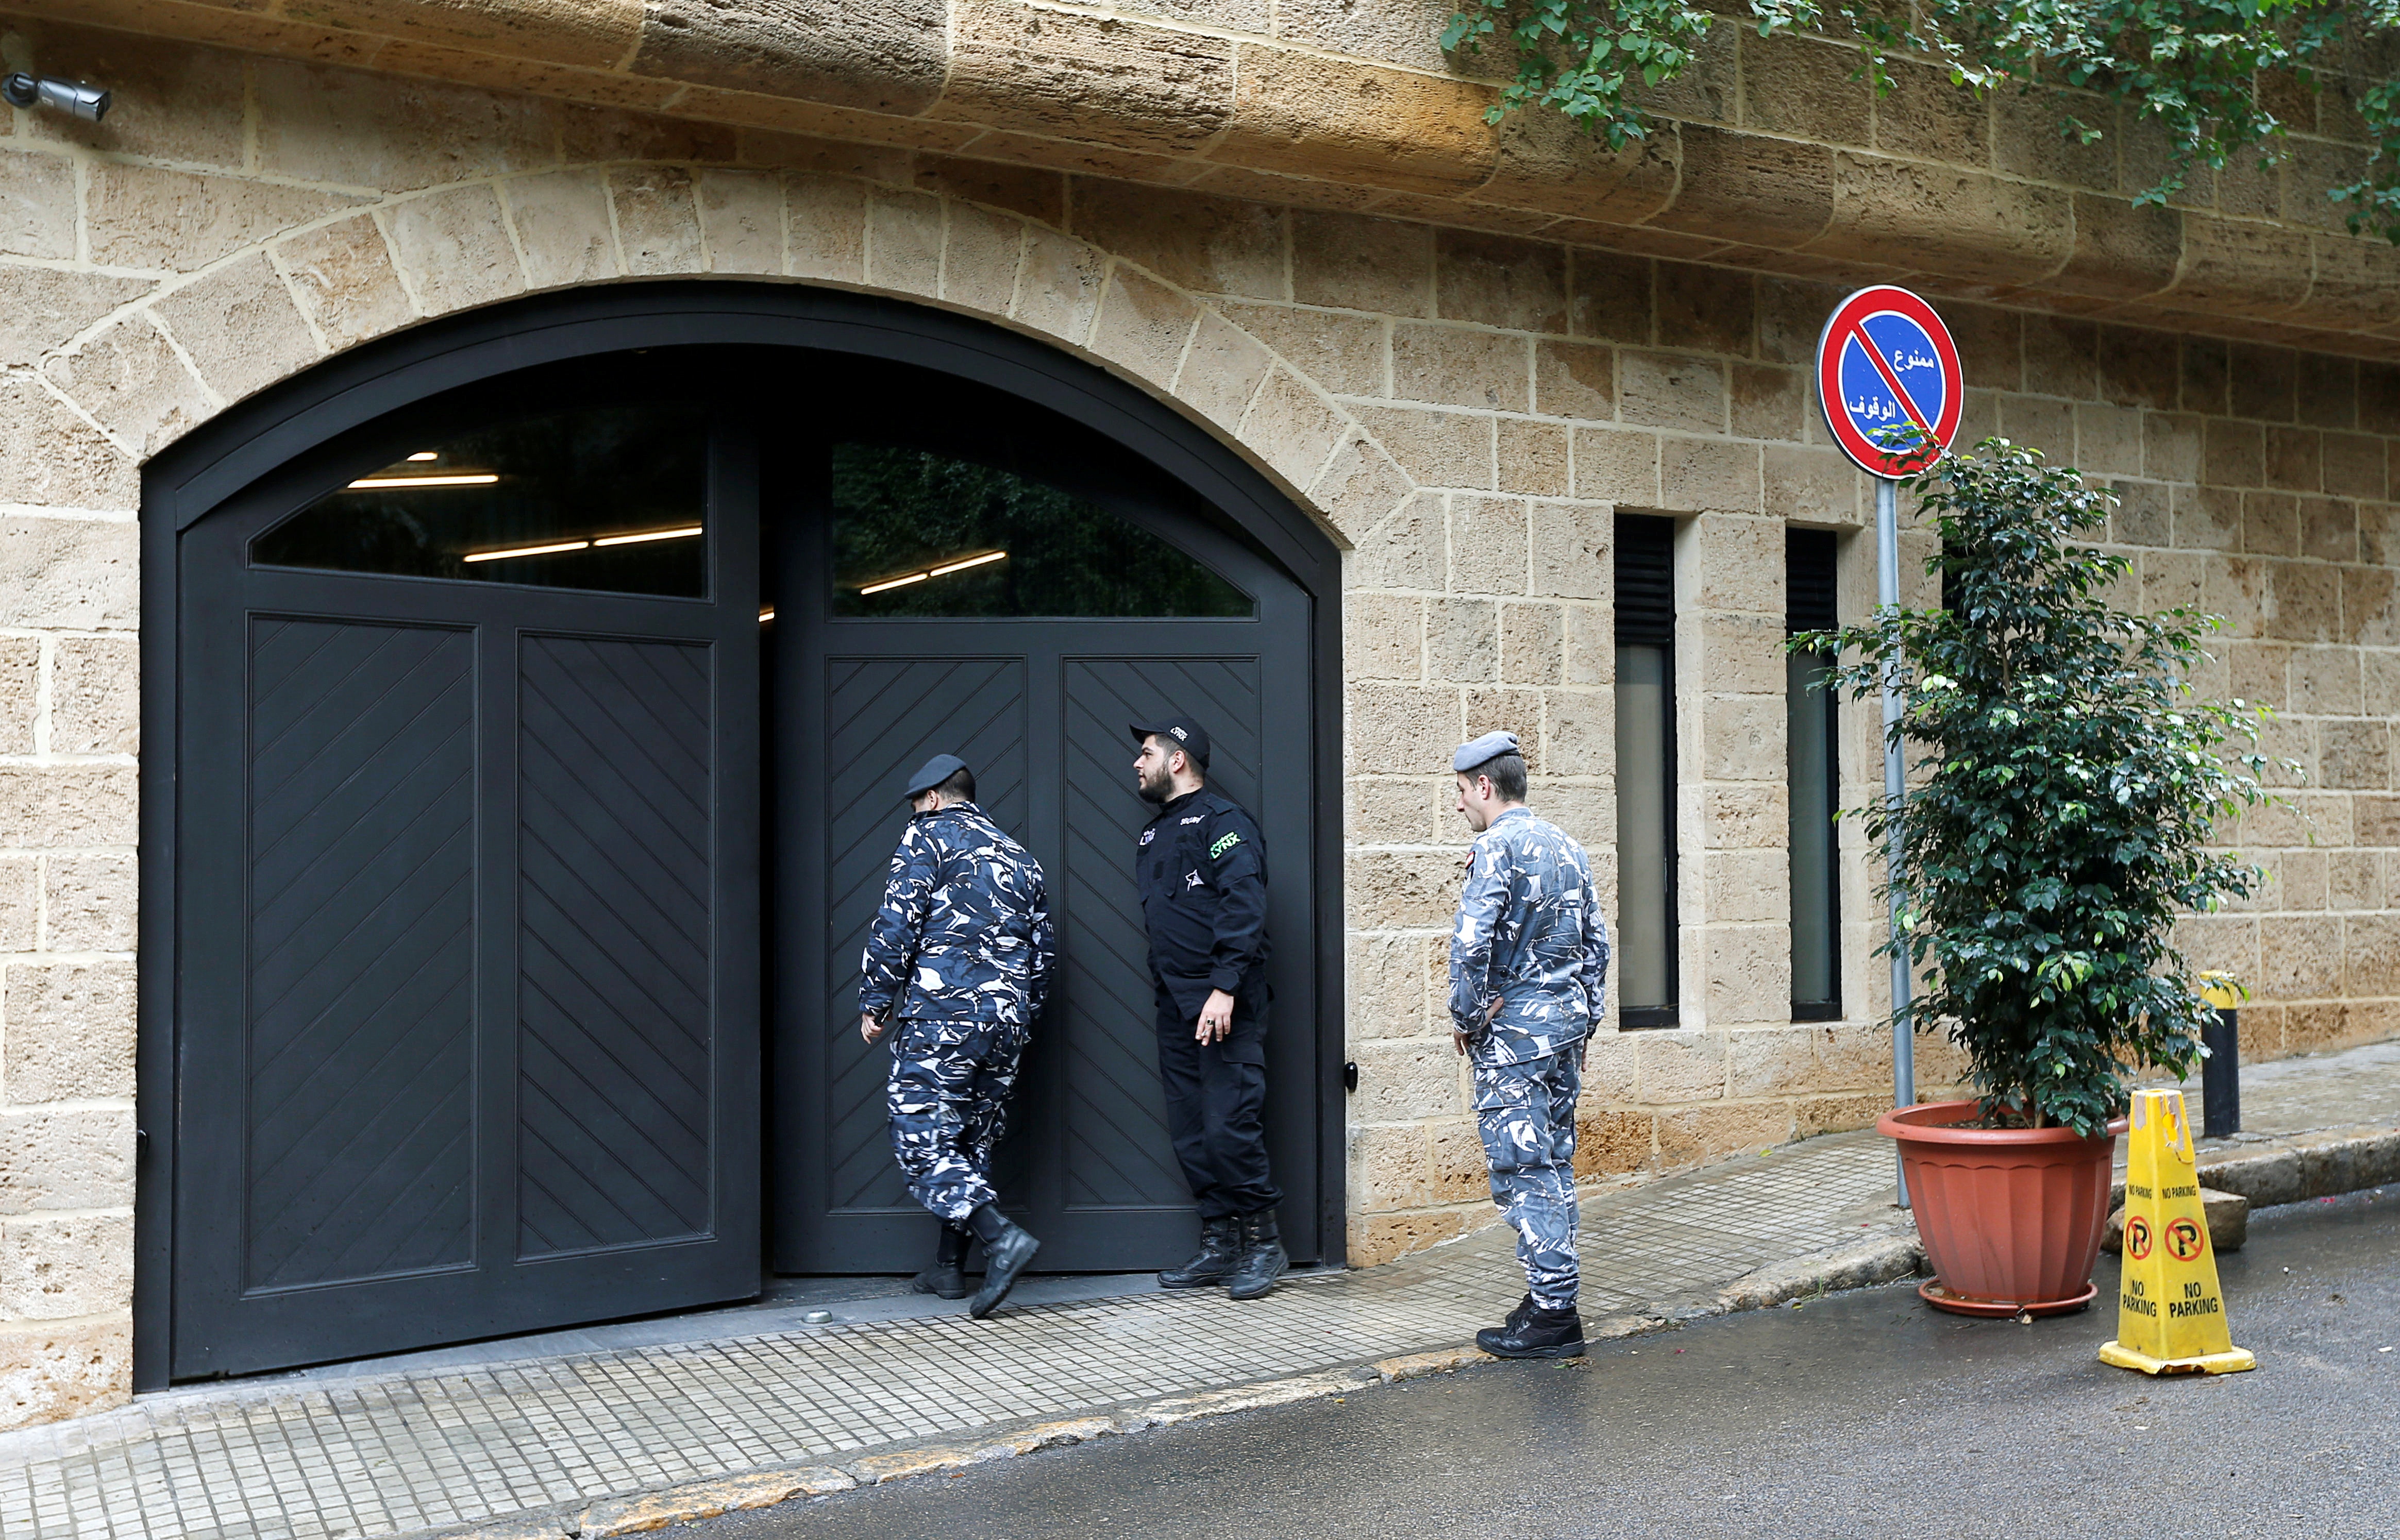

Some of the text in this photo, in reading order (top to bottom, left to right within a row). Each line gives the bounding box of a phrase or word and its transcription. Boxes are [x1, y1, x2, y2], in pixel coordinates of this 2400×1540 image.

[1893, 348, 1934, 372] ممنوع
[1849, 395, 1895, 421] الوقوف
[1211, 834, 1241, 859] LYNX
[2129, 1184, 2152, 1199] NO PARKING
[2162, 1184, 2196, 1199] NO PARKING
[2132, 1280, 2144, 1296] NO
[2184, 1282, 2202, 1299] NO
[2123, 1294, 2156, 1317] PARKING
[2169, 1297, 2218, 1318] PARKING
